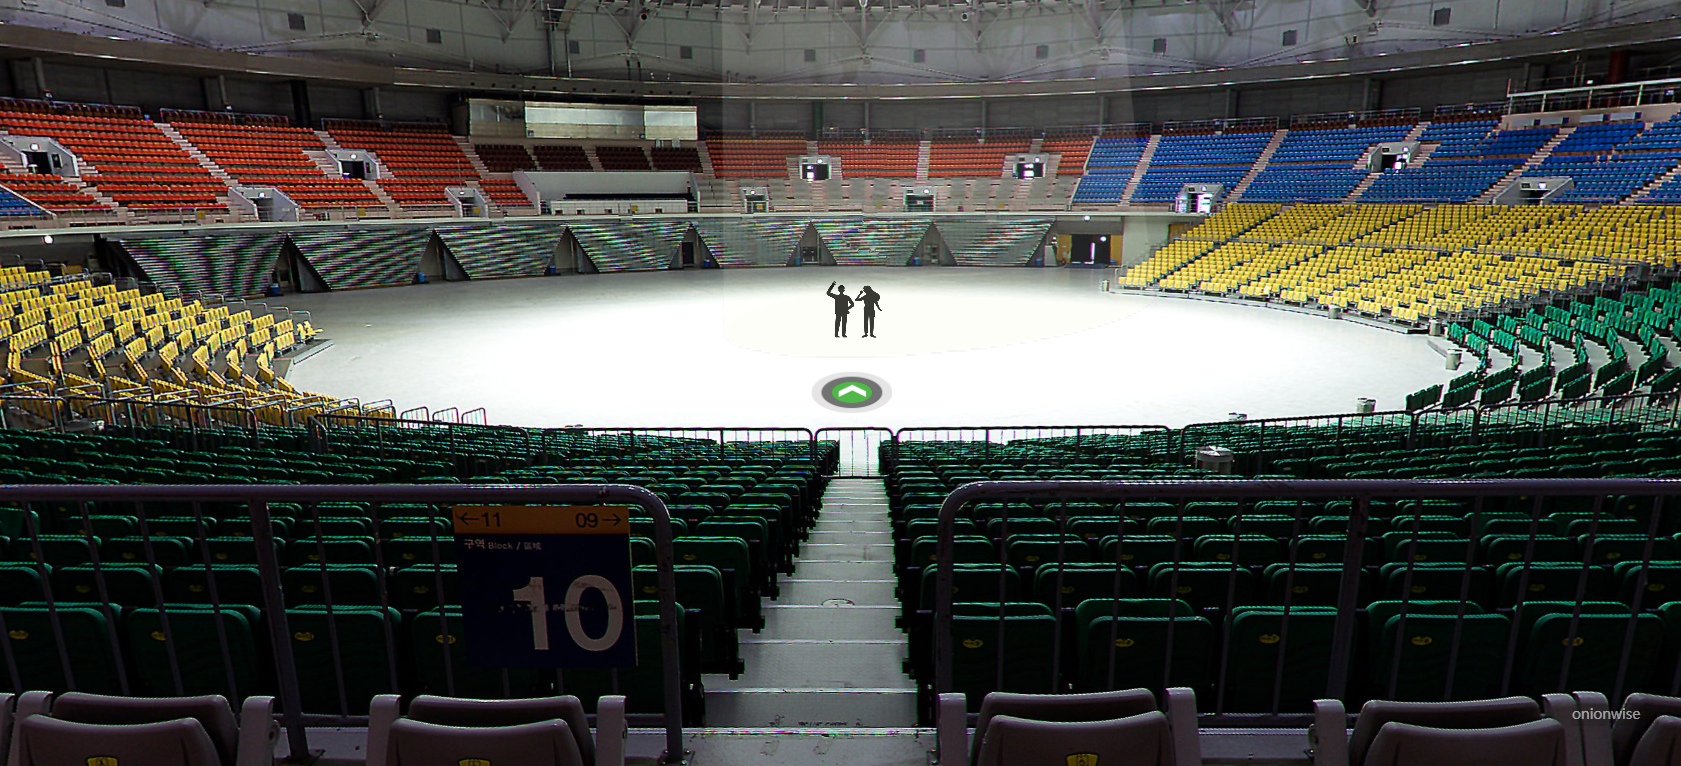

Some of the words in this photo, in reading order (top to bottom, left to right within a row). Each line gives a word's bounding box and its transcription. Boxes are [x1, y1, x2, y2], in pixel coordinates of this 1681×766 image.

[482, 512, 501, 527] 11
[575, 512, 599, 528] 09
[464, 538, 485, 550] 구역
[487, 541, 514, 550] Block
[512, 574, 624, 652] 10
